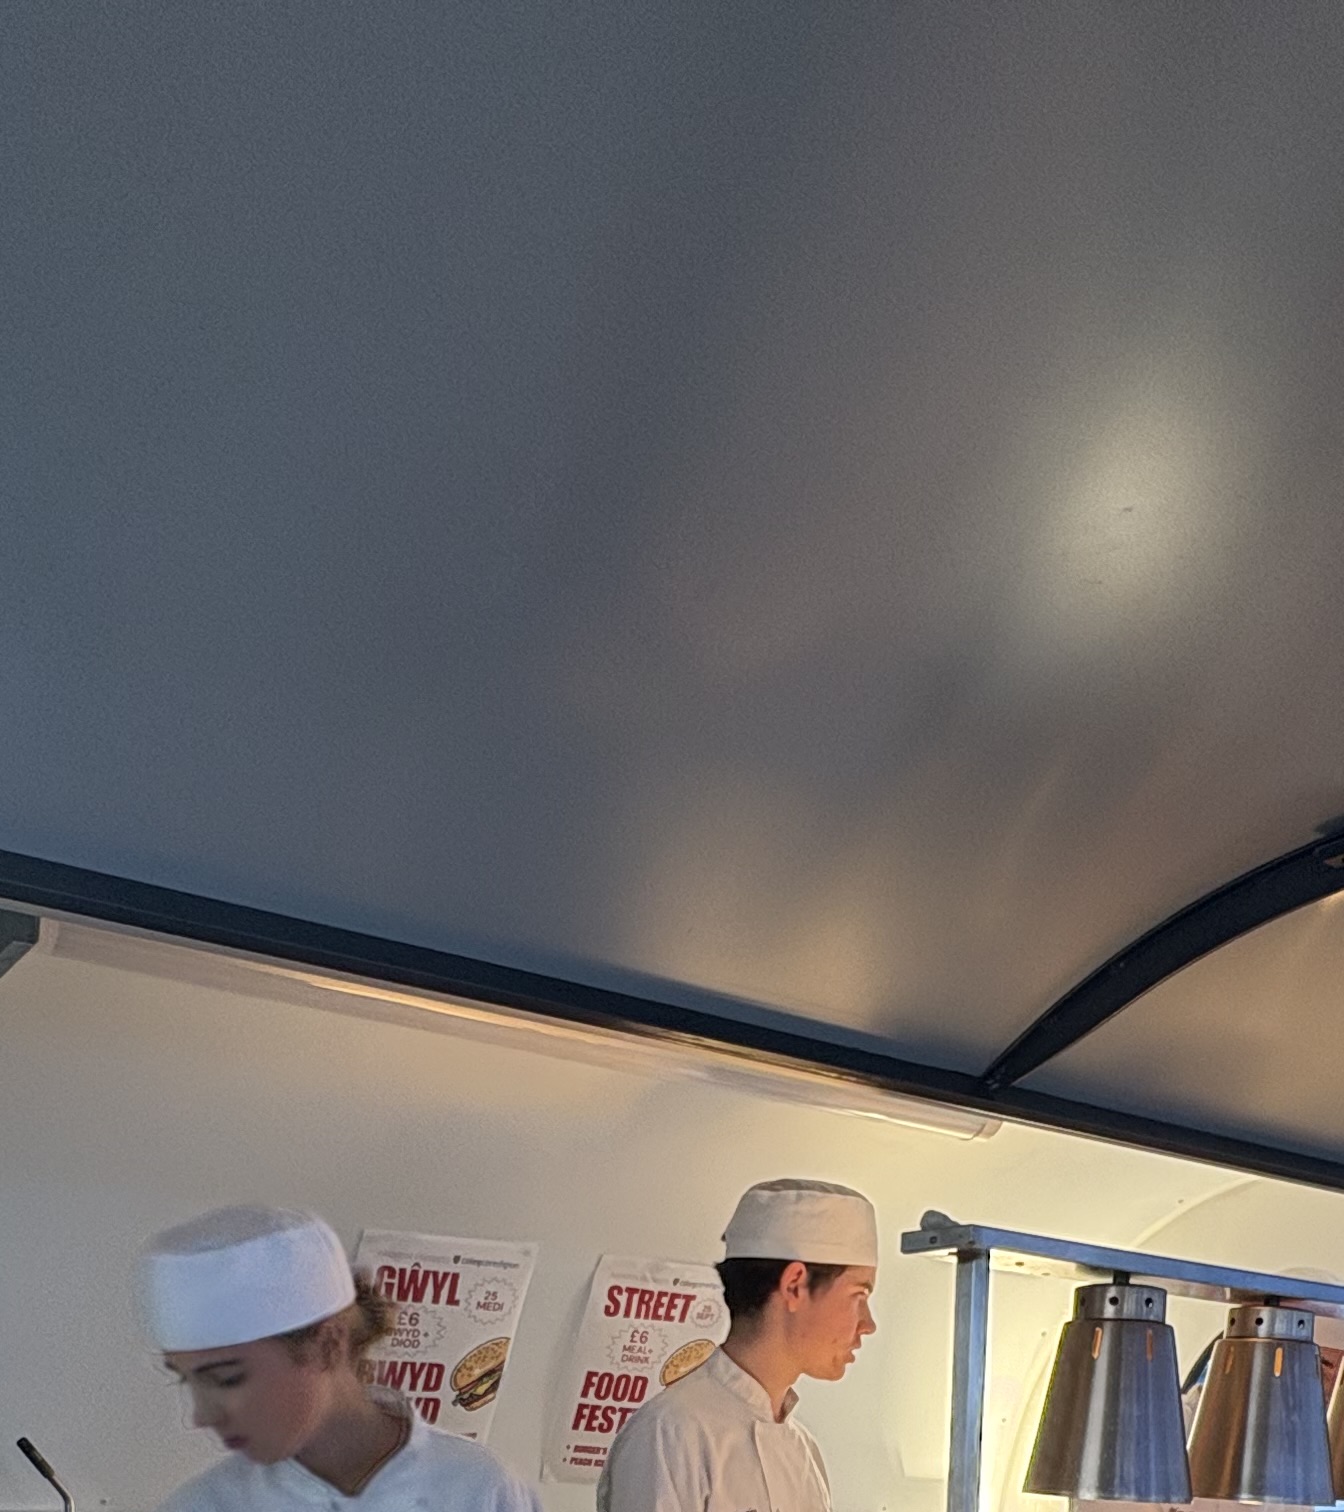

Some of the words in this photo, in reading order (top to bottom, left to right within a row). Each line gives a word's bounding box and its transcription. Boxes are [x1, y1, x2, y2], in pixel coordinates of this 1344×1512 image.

[484, 1291, 498, 1300] 25
[476, 1301, 504, 1312] MEDI
[604, 1285, 697, 1323] STREET
[397, 1312, 420, 1327] £6
[391, 1338, 421, 1349] DIOD
[630, 1330, 649, 1344] £6
[621, 1354, 651, 1364] DRINK
[580, 1371, 649, 1403] FOOD
[572, 1403, 639, 1434] FEST
